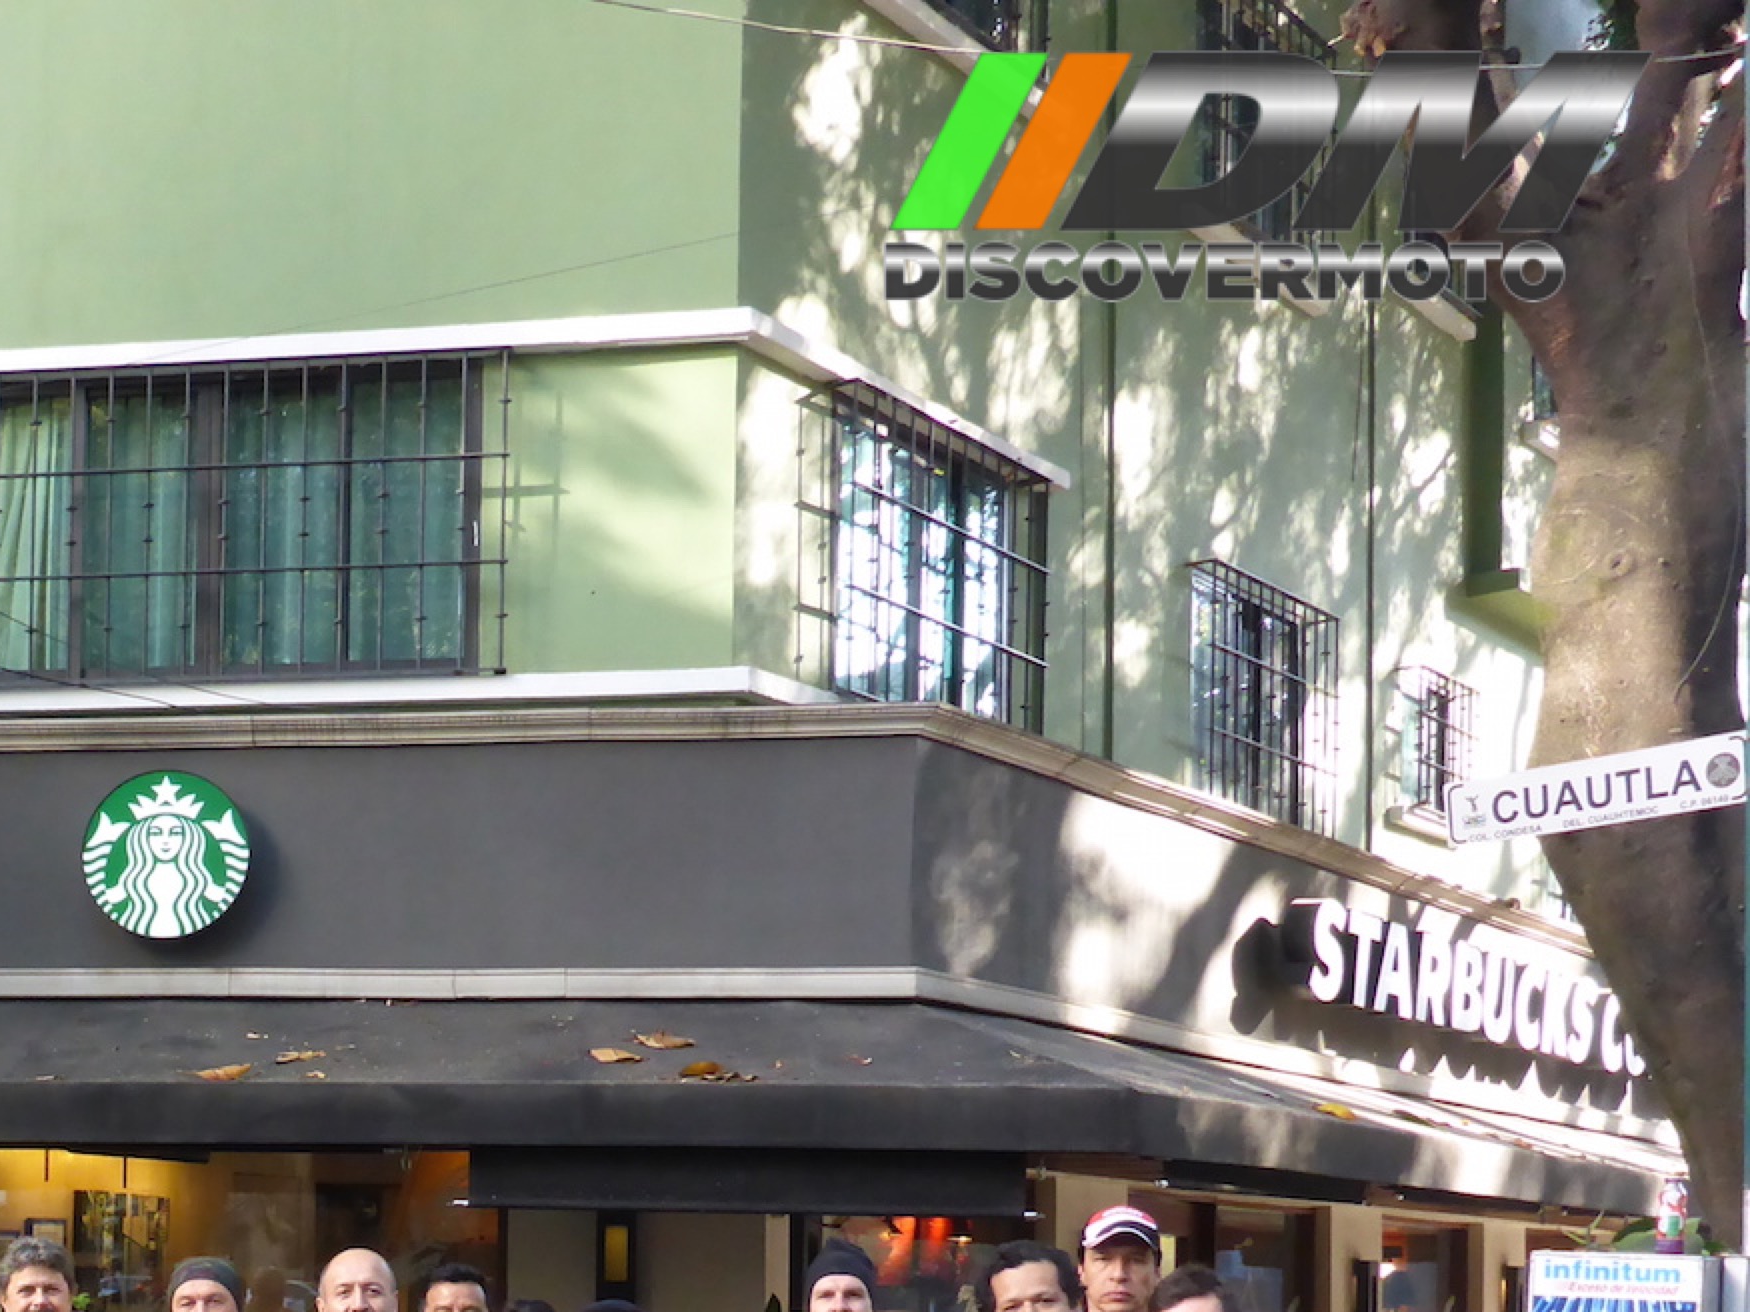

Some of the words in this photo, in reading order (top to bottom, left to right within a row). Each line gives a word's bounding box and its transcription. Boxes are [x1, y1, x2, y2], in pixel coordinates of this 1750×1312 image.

[1491, 759, 1703, 824] CUAUTLA
[1493, 824, 1543, 840] CONDESA
[1308, 898, 1595, 1065] STARBUCKS
[1601, 992, 1647, 1078] C
[1544, 1258, 1681, 1283] infinitum
